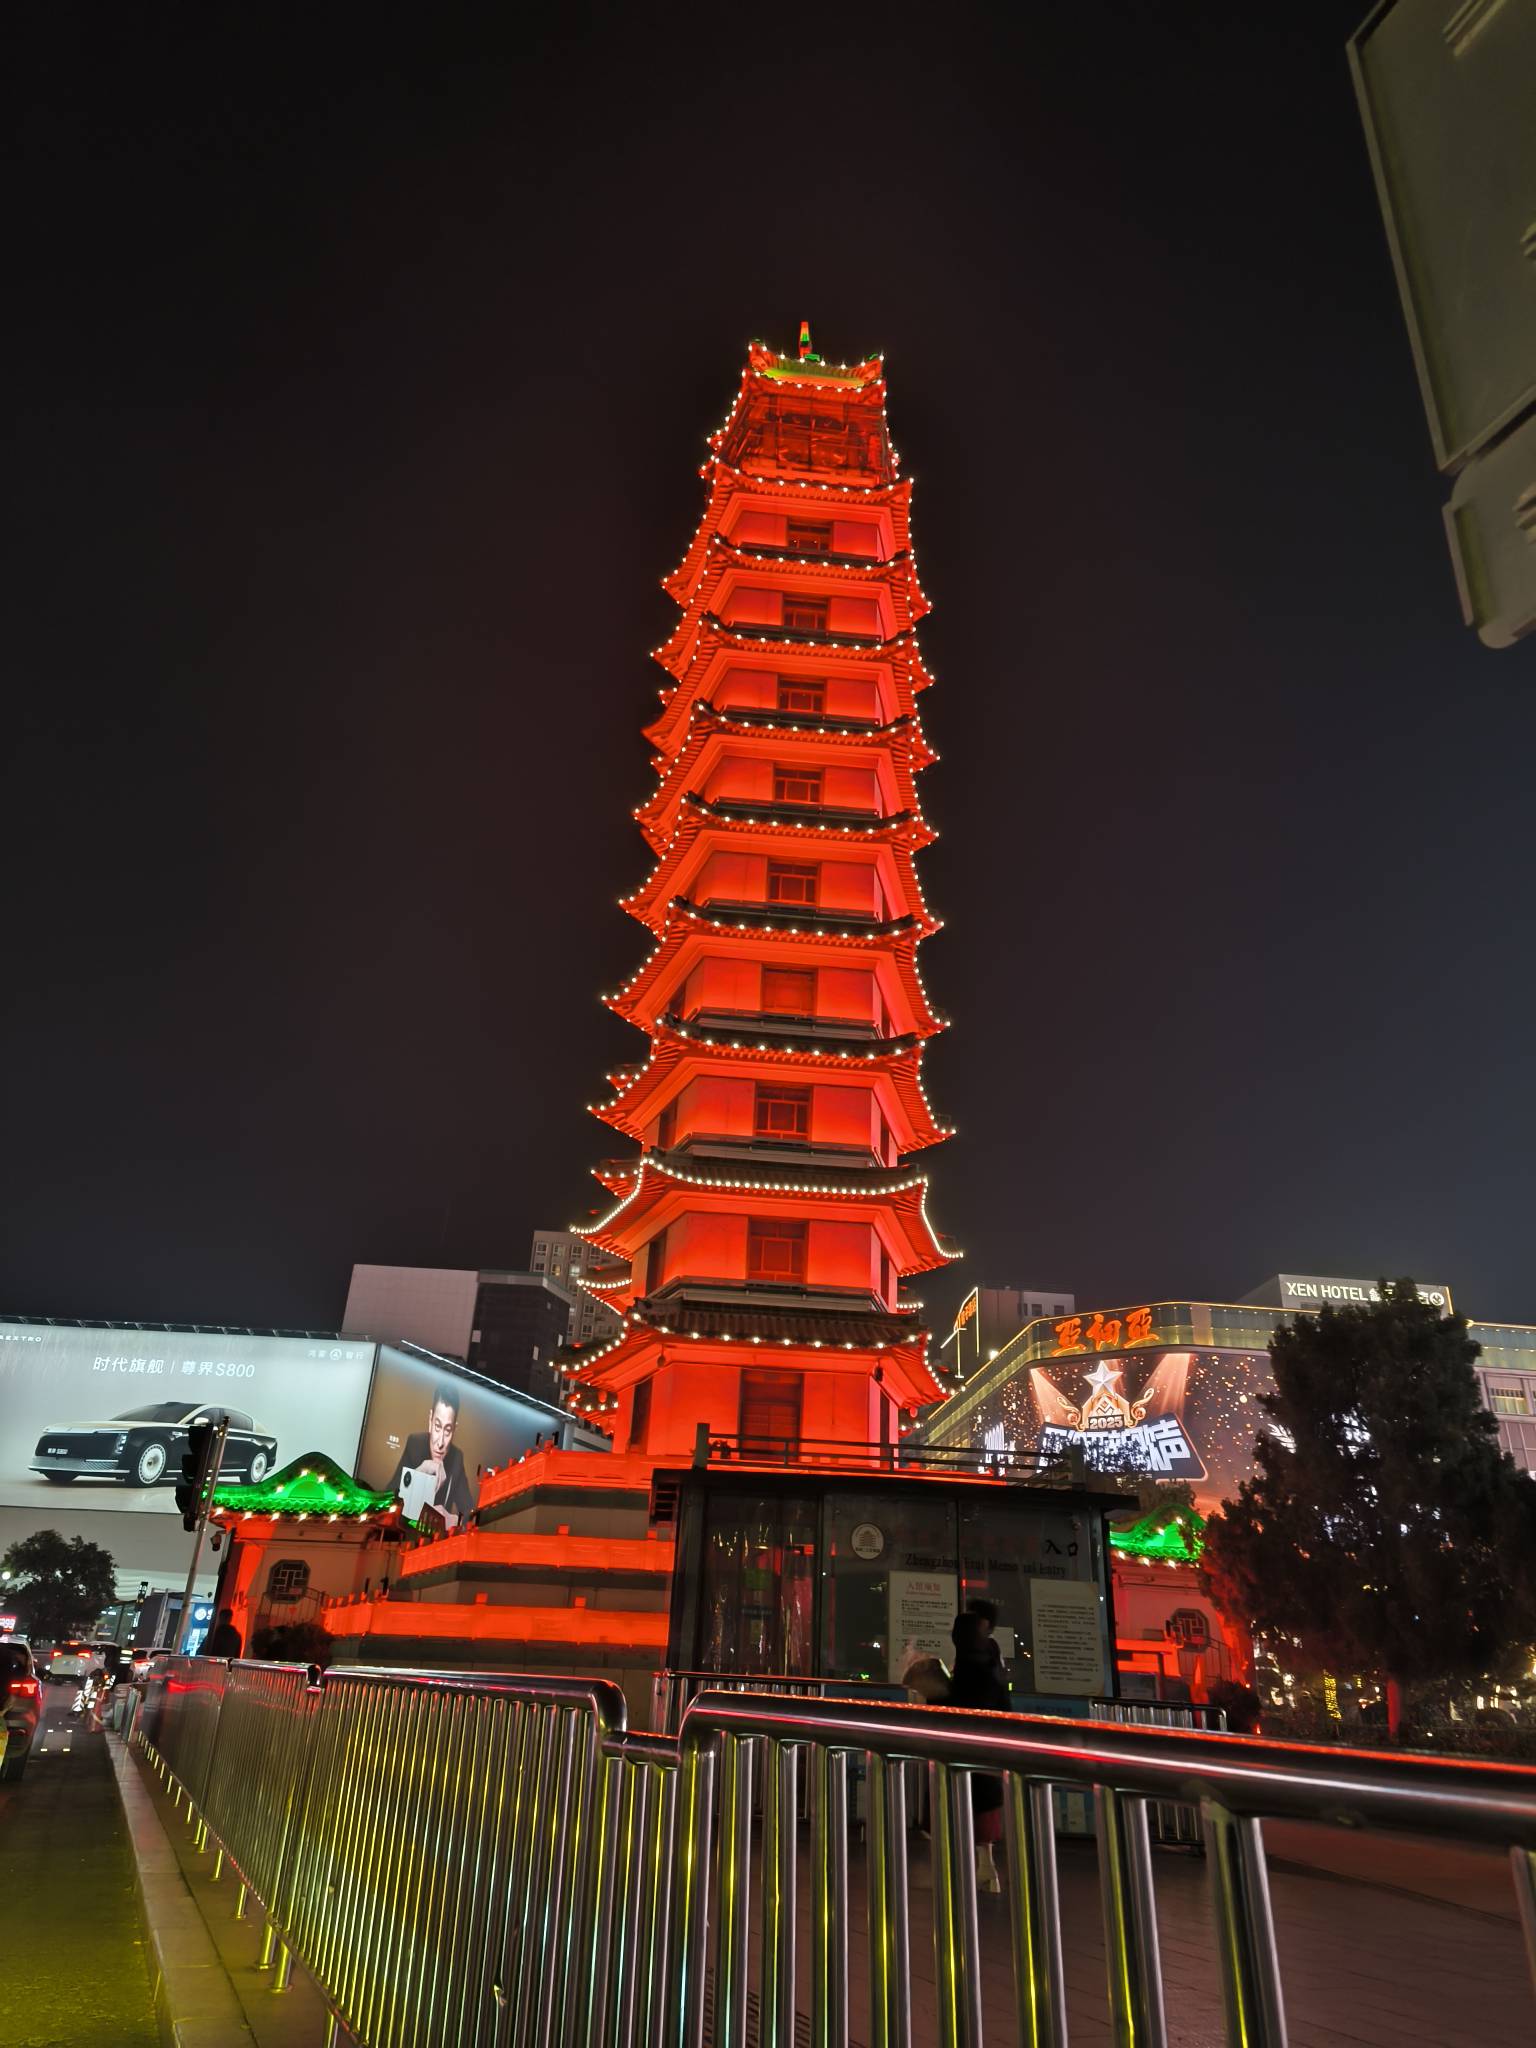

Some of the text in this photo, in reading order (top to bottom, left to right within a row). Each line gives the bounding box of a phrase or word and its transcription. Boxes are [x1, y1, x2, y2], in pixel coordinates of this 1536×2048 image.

[1286, 1282, 1318, 1298] XEN
[1321, 1284, 1369, 1302] HOTEL
[92, 1356, 255, 1378] 时代旗舰 尊界S800
[1089, 1415, 1124, 1430] 2025
[1045, 1539, 1079, 1557] 入口
